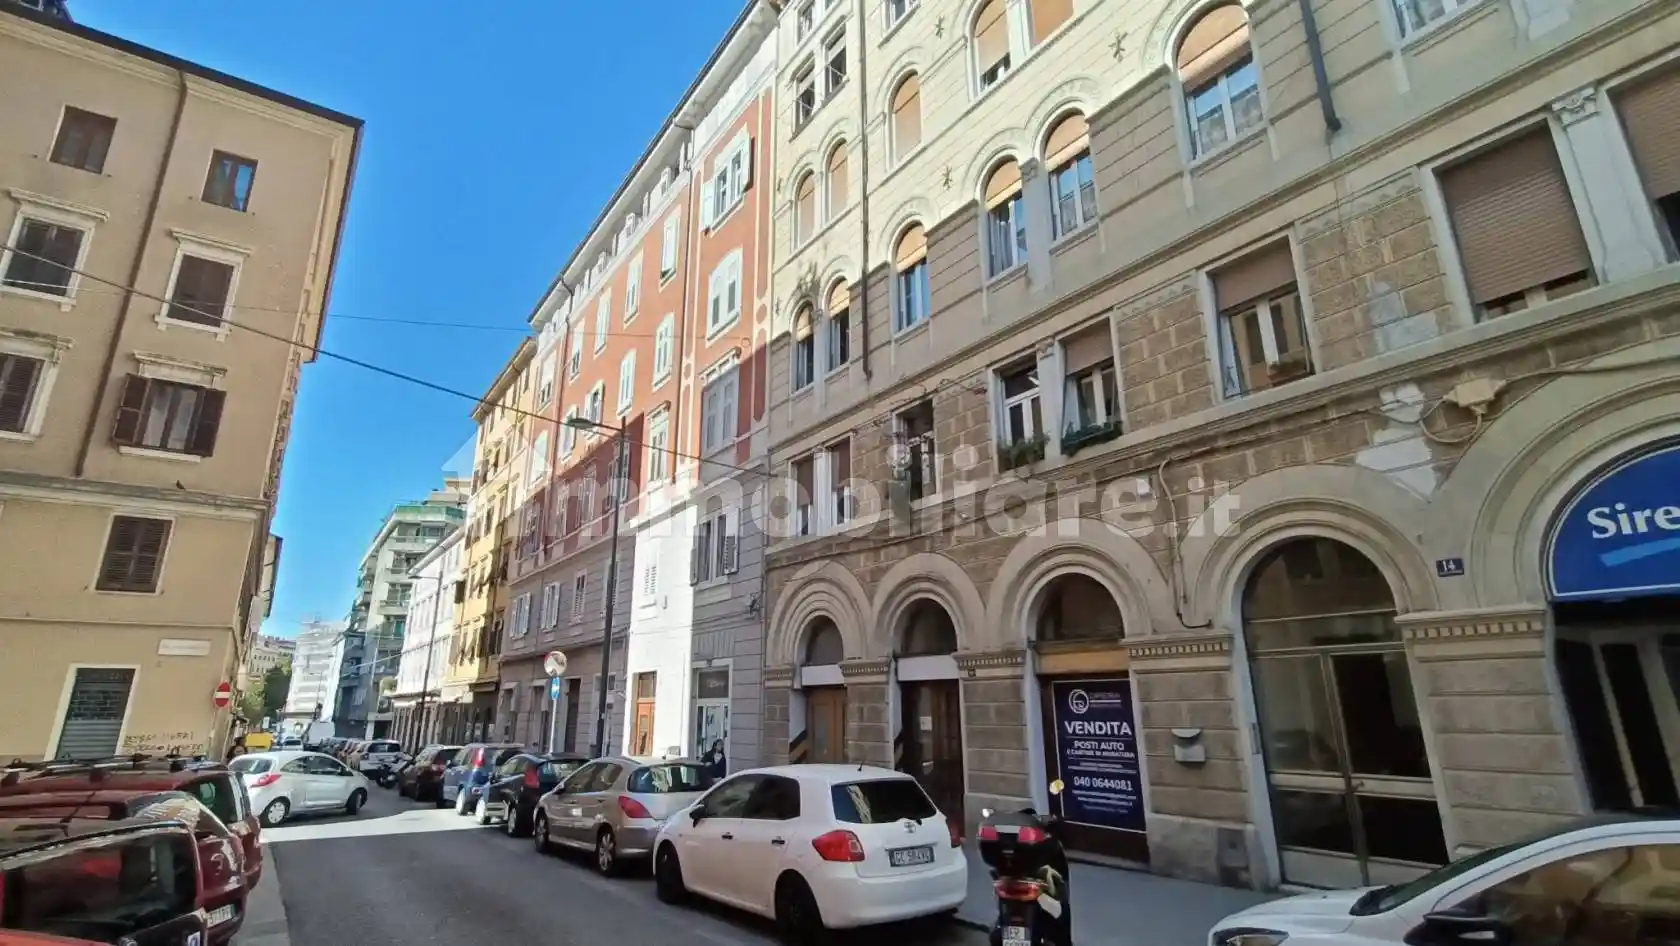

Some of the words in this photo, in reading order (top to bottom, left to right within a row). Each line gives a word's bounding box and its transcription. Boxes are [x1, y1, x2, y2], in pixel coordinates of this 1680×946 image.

[1442, 559, 1457, 573] 14
[1064, 721, 1132, 735] VENDITA
[1073, 741, 1099, 750] POSTI
[1100, 741, 1125, 751] AUTO
[1073, 775, 1091, 788] 040
[1091, 777, 1133, 791] 0644081
